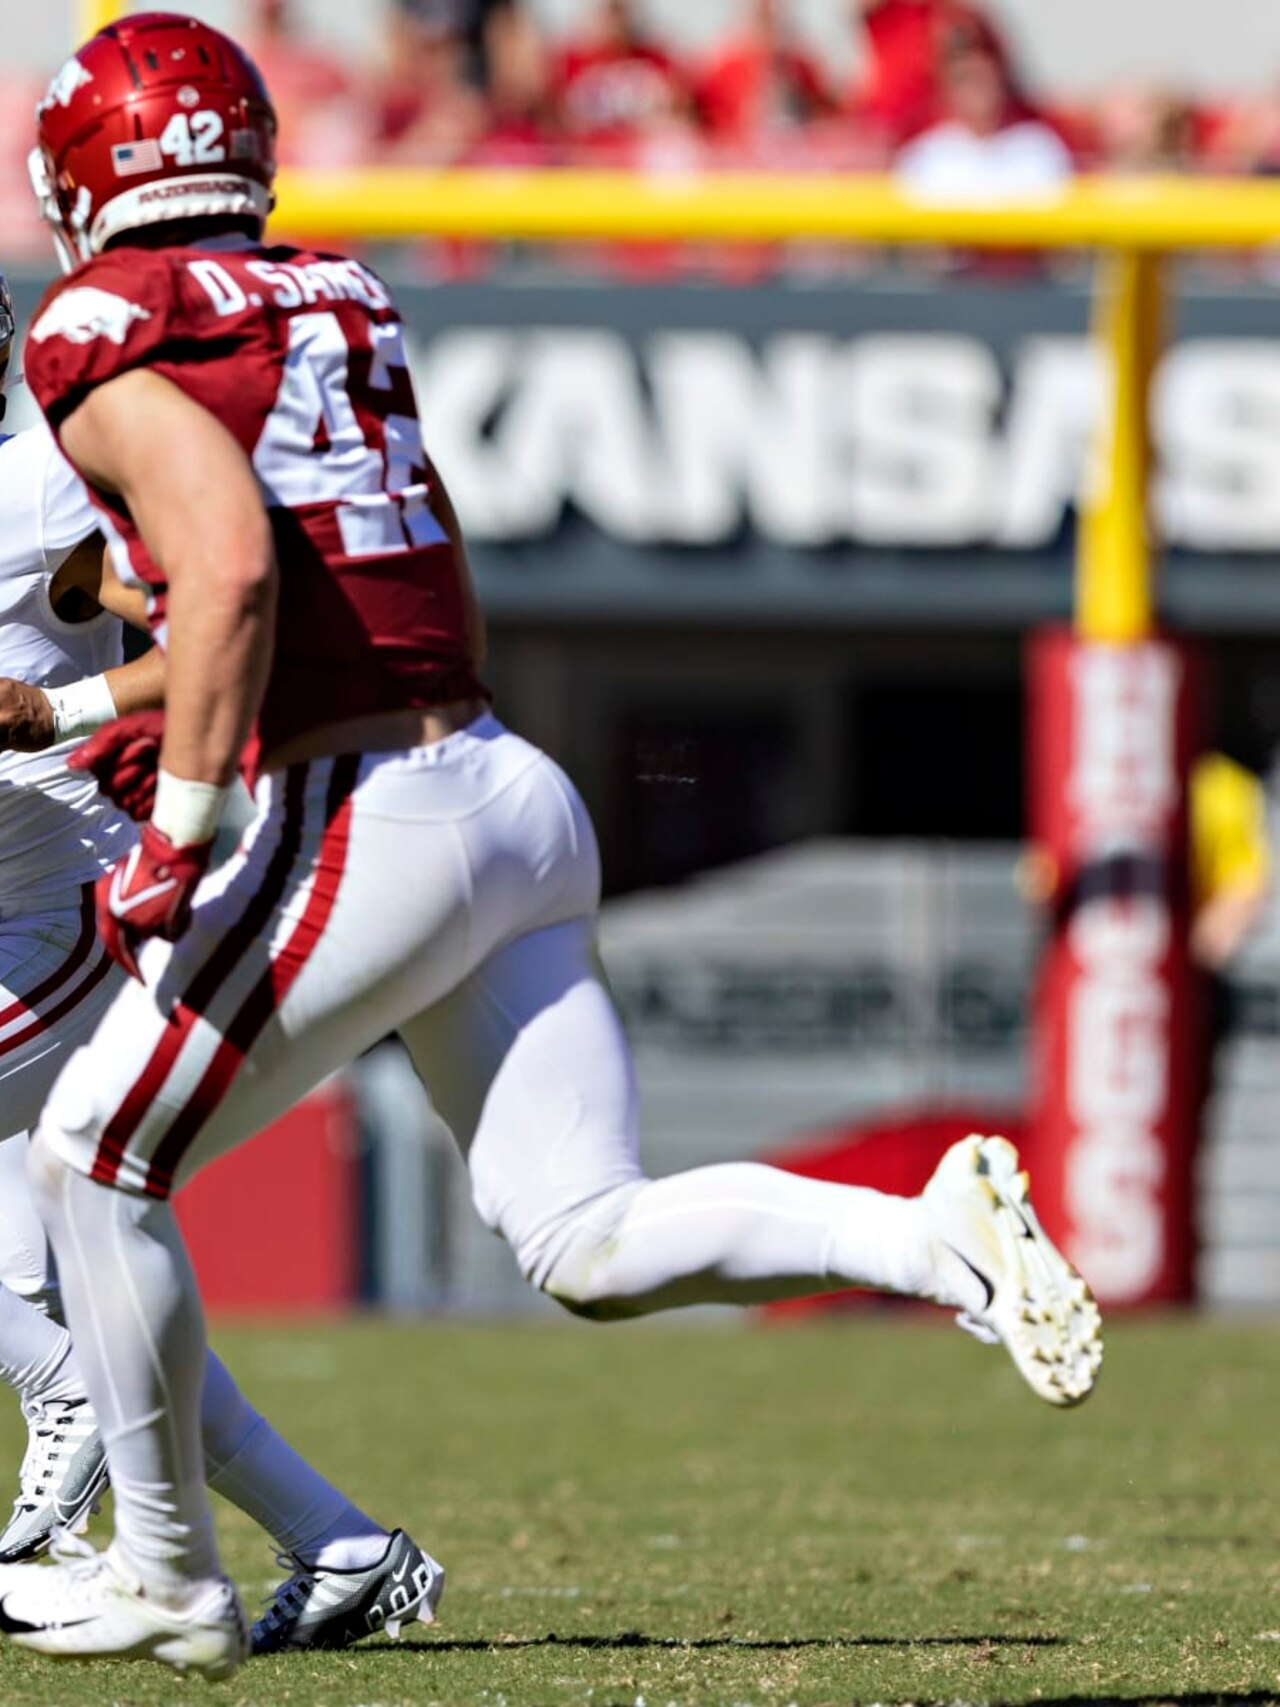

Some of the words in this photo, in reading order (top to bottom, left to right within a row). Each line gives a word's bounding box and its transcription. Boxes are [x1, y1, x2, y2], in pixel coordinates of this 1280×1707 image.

[160, 110, 225, 166] 42
[187, 260, 263, 316] D.
[253, 312, 450, 557] 42
